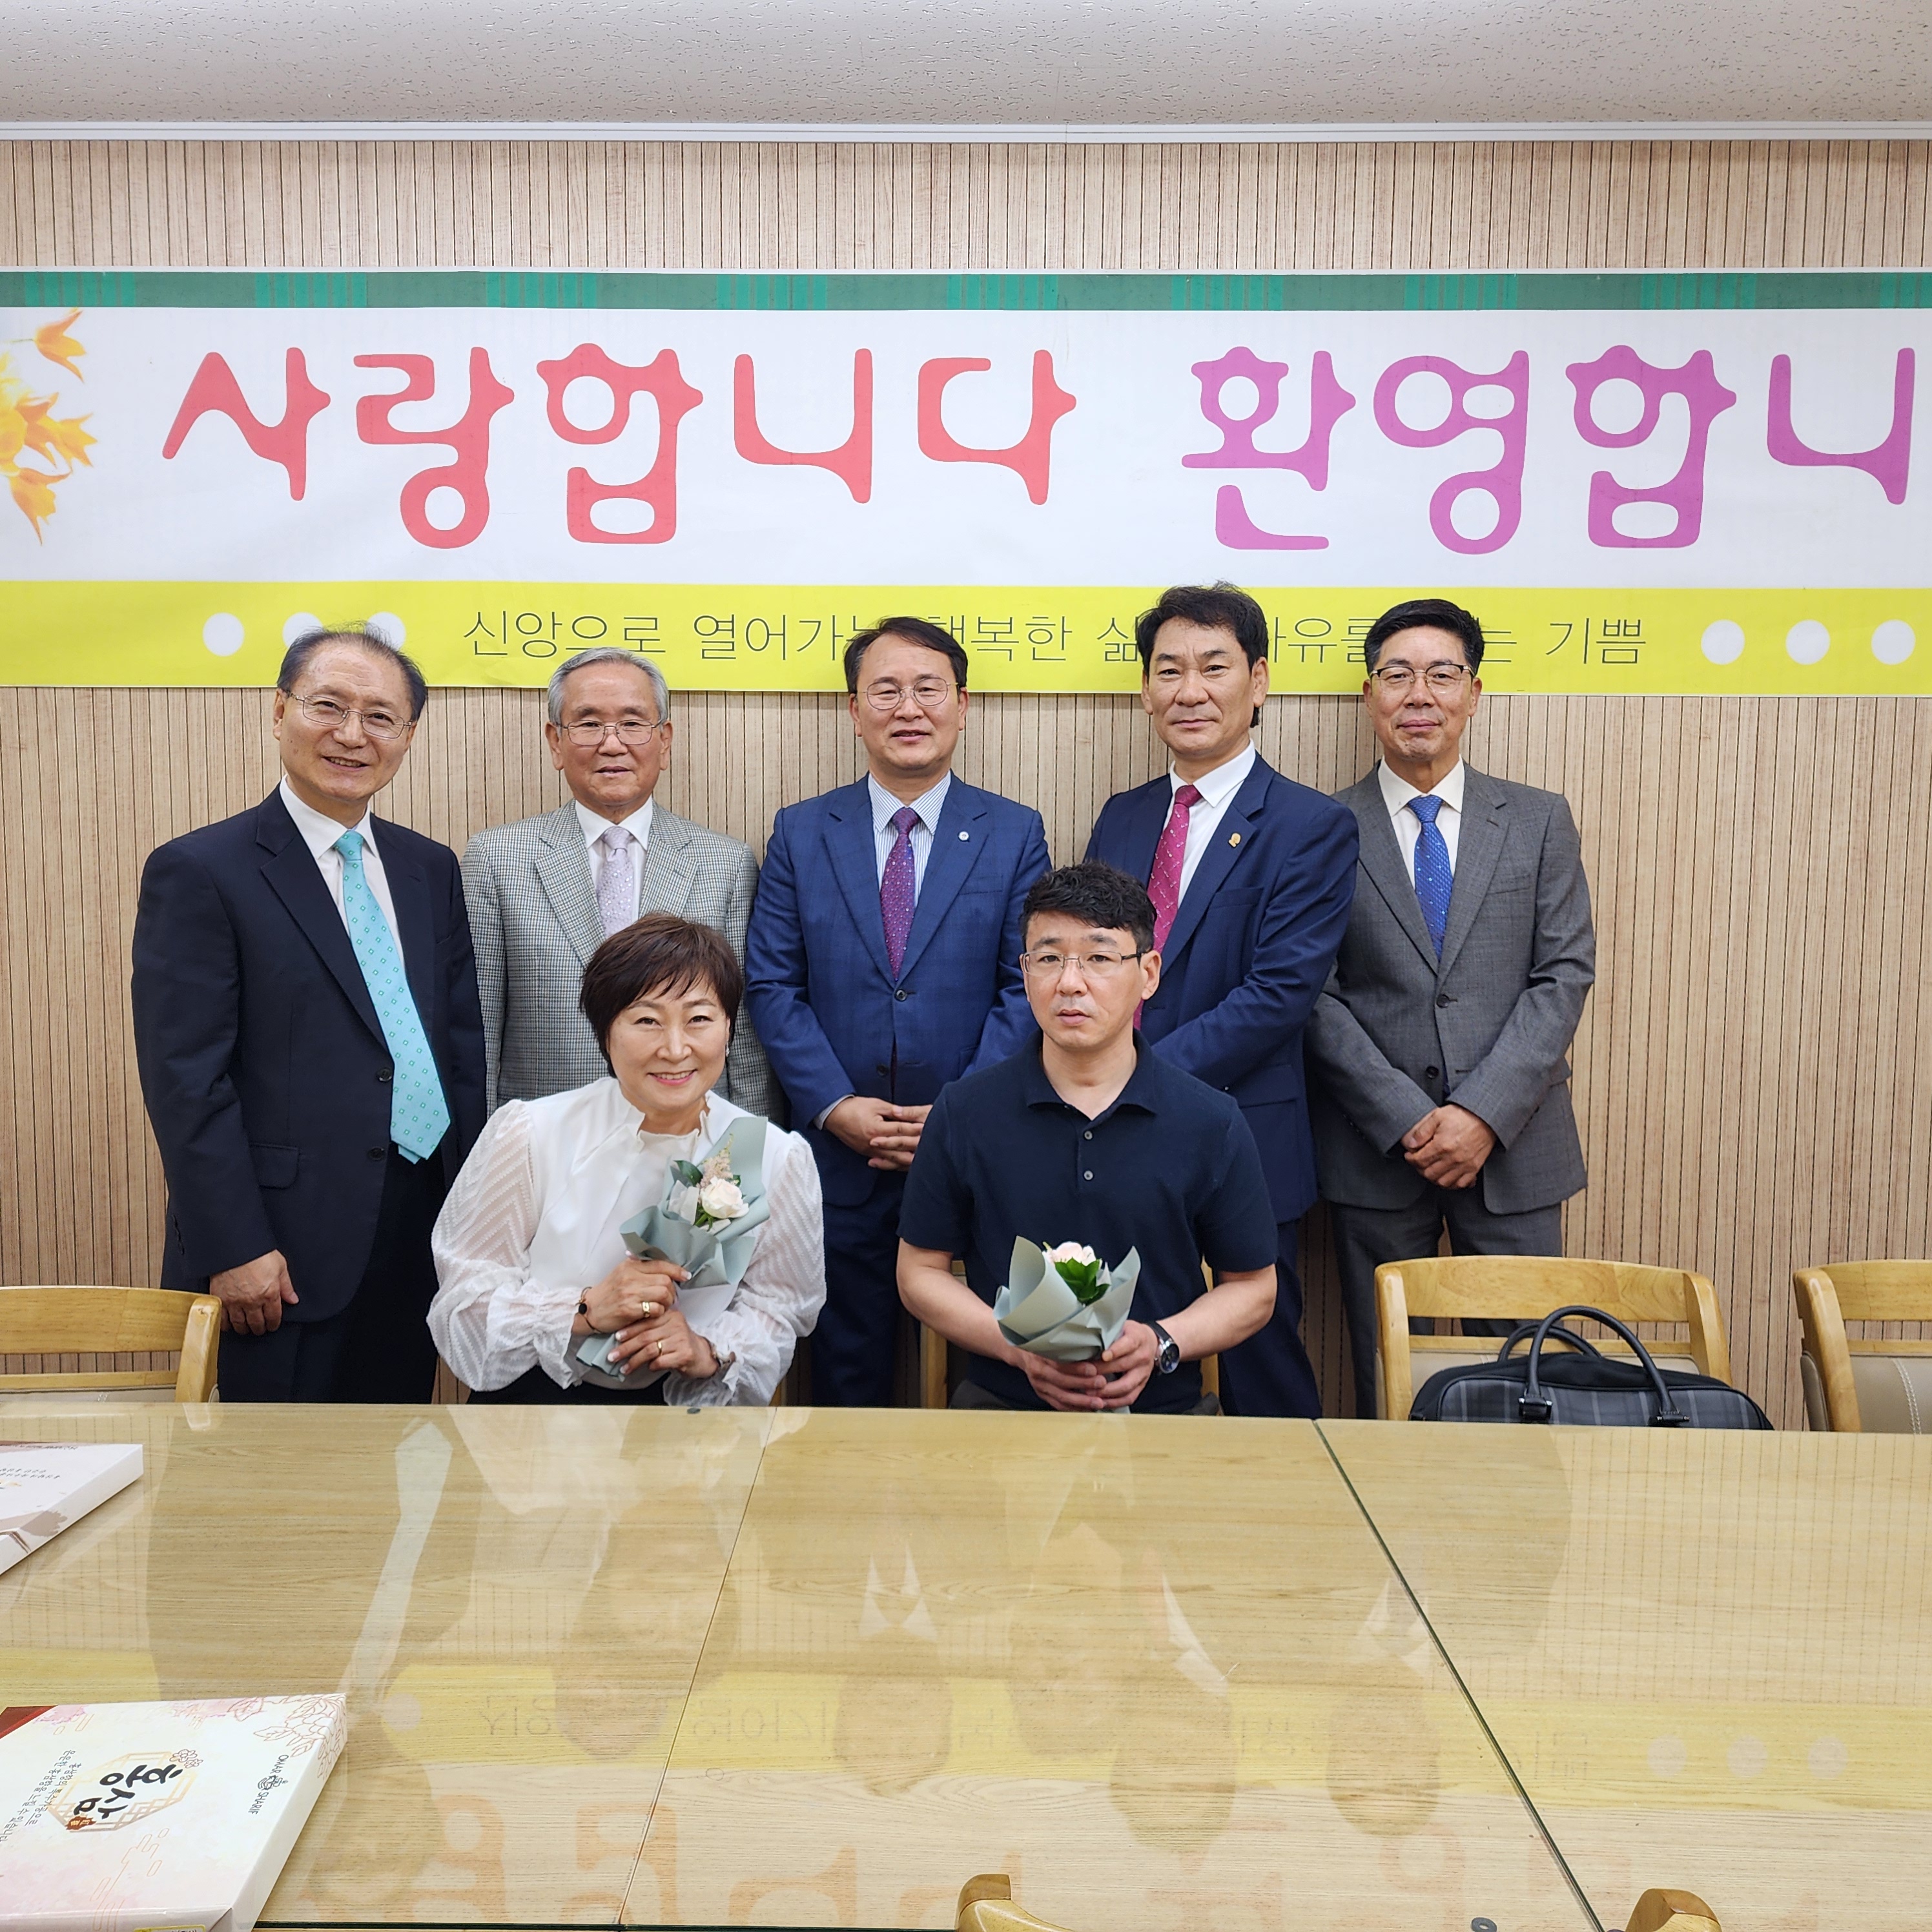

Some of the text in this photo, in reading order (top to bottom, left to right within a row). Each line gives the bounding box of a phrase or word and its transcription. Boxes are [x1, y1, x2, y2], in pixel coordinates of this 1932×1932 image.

[163, 344, 1915, 554] 사랑합니다 환영합니
[464, 610, 666, 659] 신앙으로
[1545, 617, 1647, 664] 기쁨
[54, 1749, 76, 1767] 은은한
[270, 1754, 288, 1774] OMAR
[34, 1769, 61, 1793] 홍삼향을
[55, 1763, 81, 1786] 홍삼향의
[248, 1792, 269, 1815] SHARIF
